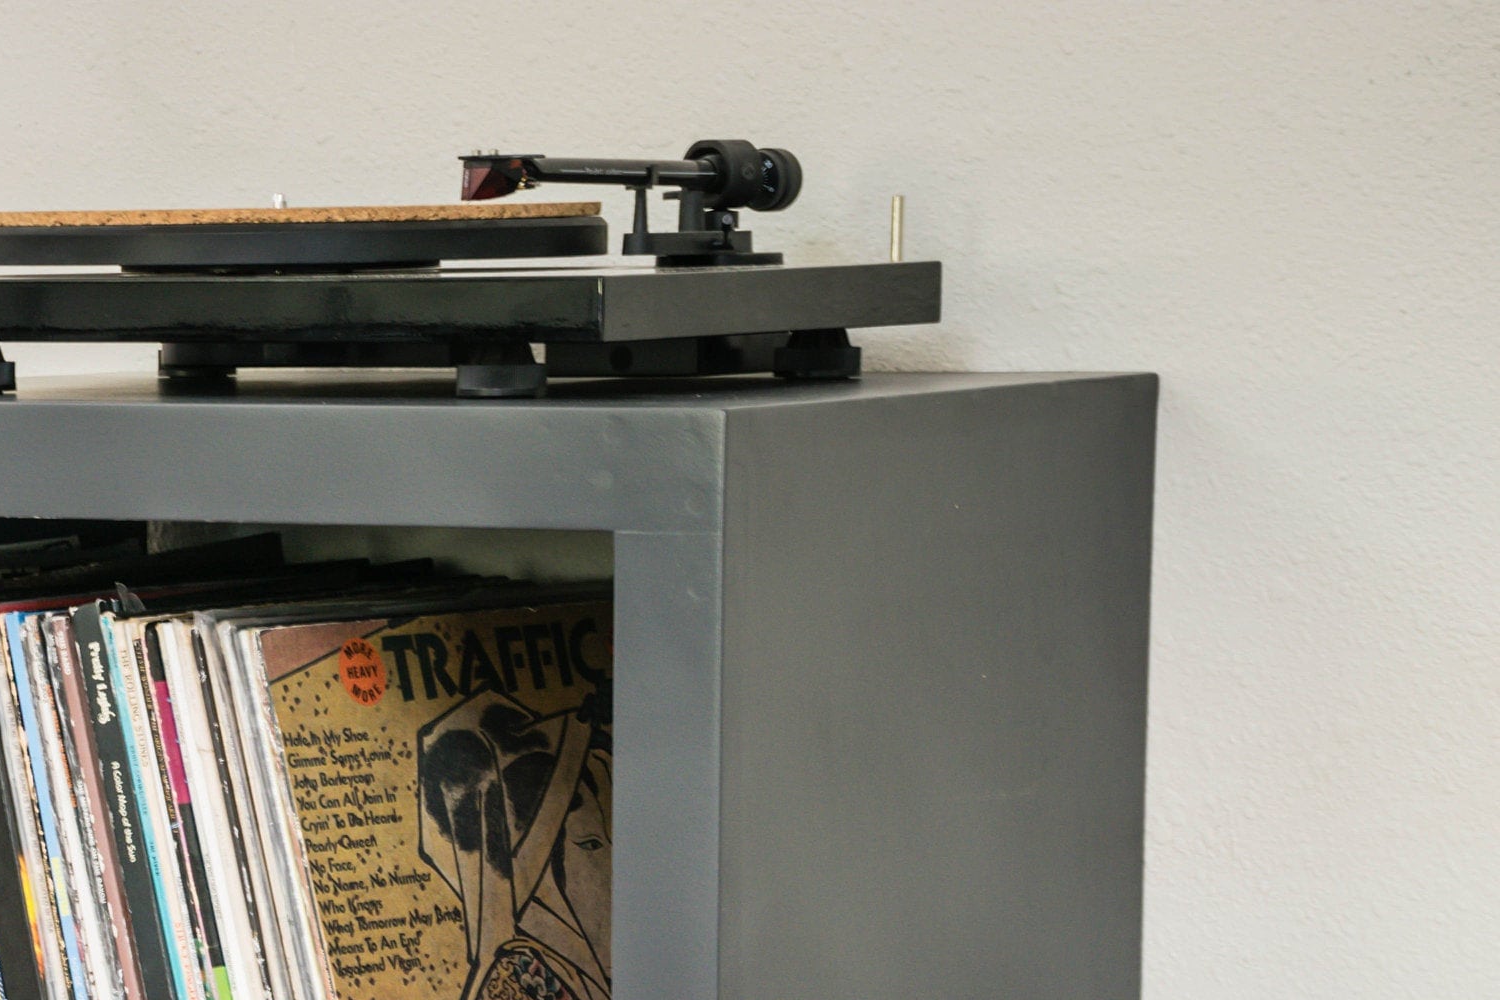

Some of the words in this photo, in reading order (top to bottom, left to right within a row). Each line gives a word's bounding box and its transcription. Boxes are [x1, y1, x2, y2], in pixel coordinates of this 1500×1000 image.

[56, 631, 67, 649] THE
[343, 639, 376, 660] MORE
[60, 652, 71, 675] BAND
[88, 642, 105, 680] Pretty
[121, 649, 130, 669] THE
[382, 618, 613, 702] TRAFFIC
[346, 662, 378, 680] HEAVY
[125, 674, 141, 721] ROLLING
[351, 681, 383, 703] MORE
[136, 726, 151, 768] STONES
[324, 731, 341, 746] My
[343, 728, 370, 743] Shoe
[111, 761, 119, 769] A
[288, 754, 327, 769] Gimme
[331, 750, 361, 766] Some
[113, 771, 124, 793] Color
[320, 771, 375, 787] Barleycorn
[117, 795, 129, 814] Map
[298, 797, 317, 811] You
[319, 794, 341, 808] Can
[343, 789, 359, 807] All
[362, 792, 384, 803] Join
[385, 788, 397, 802] In
[122, 816, 131, 827] of
[333, 815, 346, 829] To
[125, 828, 133, 842] the
[305, 838, 338, 854] Pearly
[340, 834, 378, 849] Queen
[128, 844, 137, 863] Sun
[311, 860, 326, 874] No
[328, 858, 356, 873] Face,
[314, 880, 331, 895] No
[333, 878, 369, 894] Name,
[370, 873, 386, 889] No
[389, 870, 432, 886] Number
[318, 901, 346, 915] Who
[348, 898, 384, 914] Knows
[323, 921, 355, 936] What
[356, 914, 407, 931] Tomorrow
[409, 909, 433, 928] May
[328, 939, 364, 956] Means
[365, 936, 378, 953] To
[380, 935, 398, 950] An
[400, 931, 422, 949] End
[332, 957, 386, 977] Vagabond
[387, 954, 422, 974] Virgin
